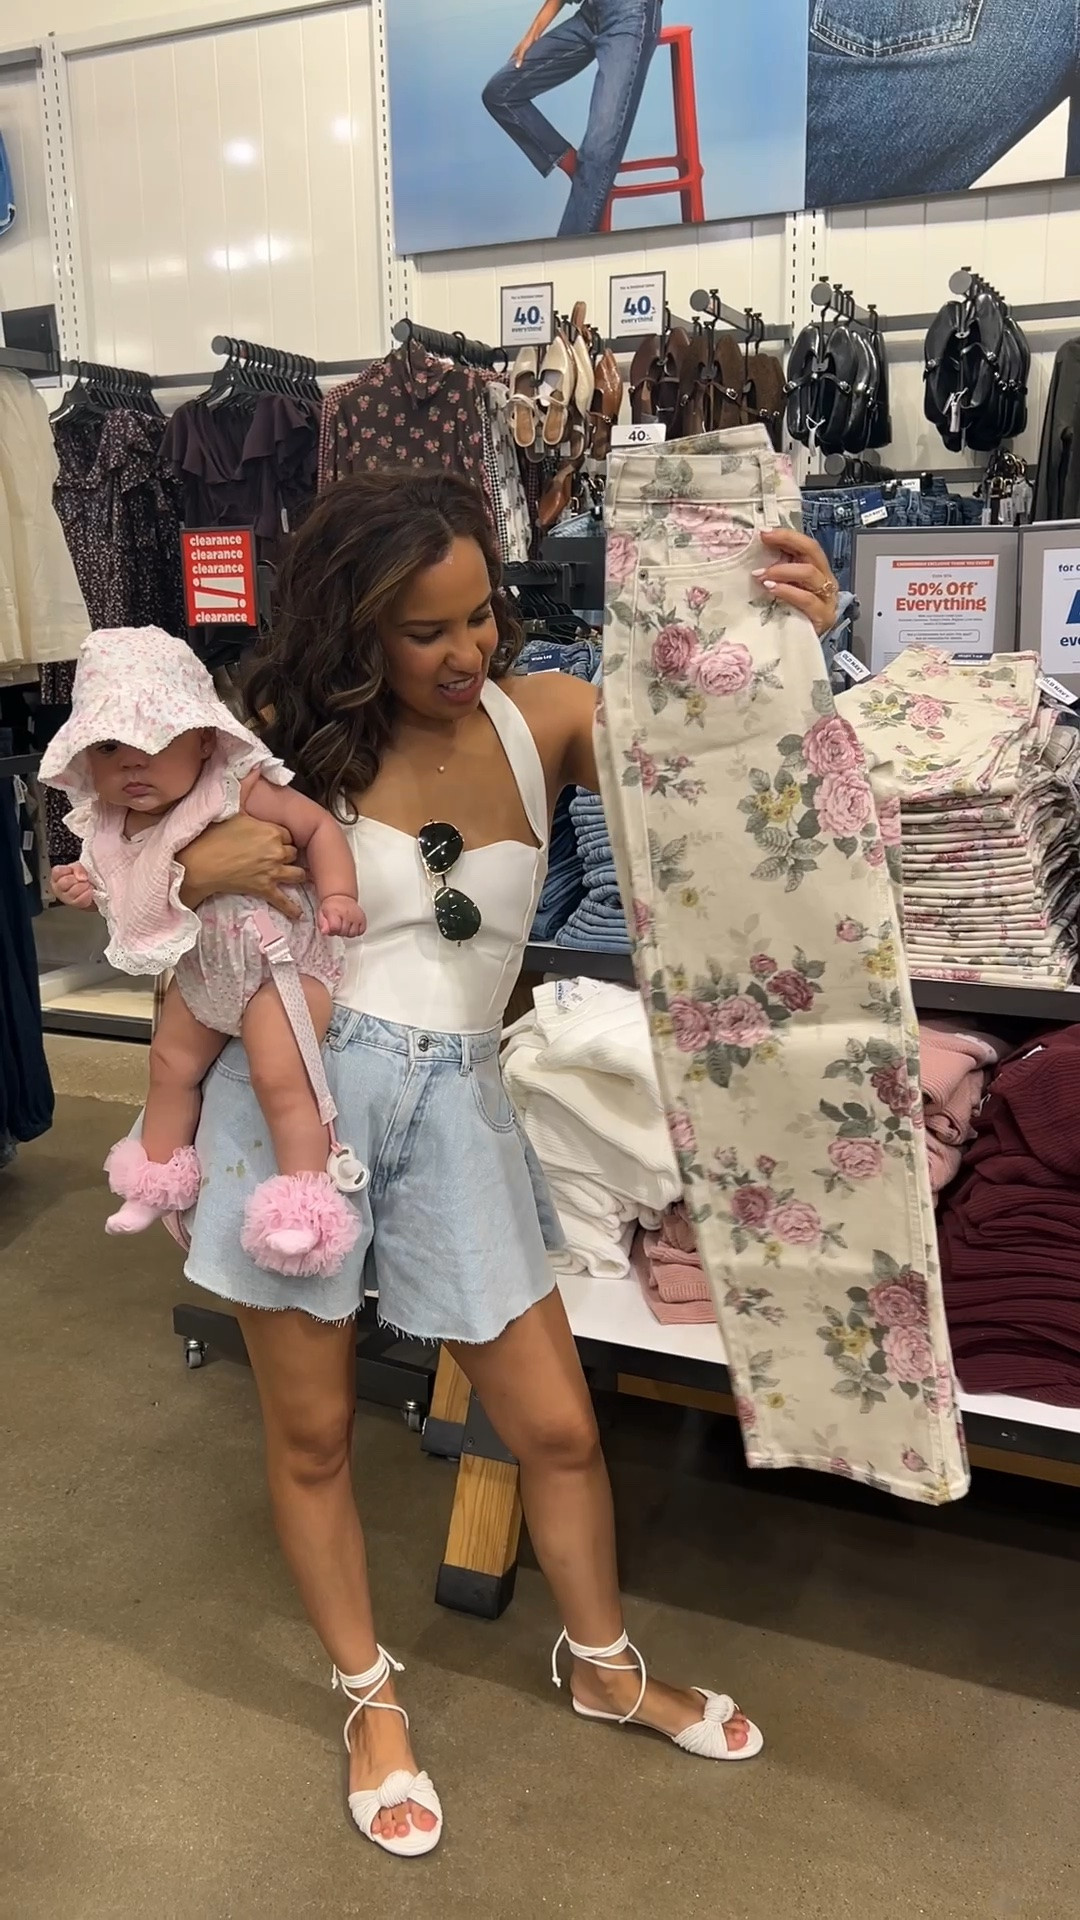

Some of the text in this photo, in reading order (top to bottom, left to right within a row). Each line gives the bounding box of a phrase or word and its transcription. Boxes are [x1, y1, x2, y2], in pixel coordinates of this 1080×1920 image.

[190, 534, 242, 546] clearance
[191, 549, 243, 560] clearance
[192, 563, 244, 574] clearance
[1058, 564, 1074, 572] for
[908, 582, 943, 596] 50%
[896, 596, 986, 612] Everything
[196, 612, 248, 622] clearance
